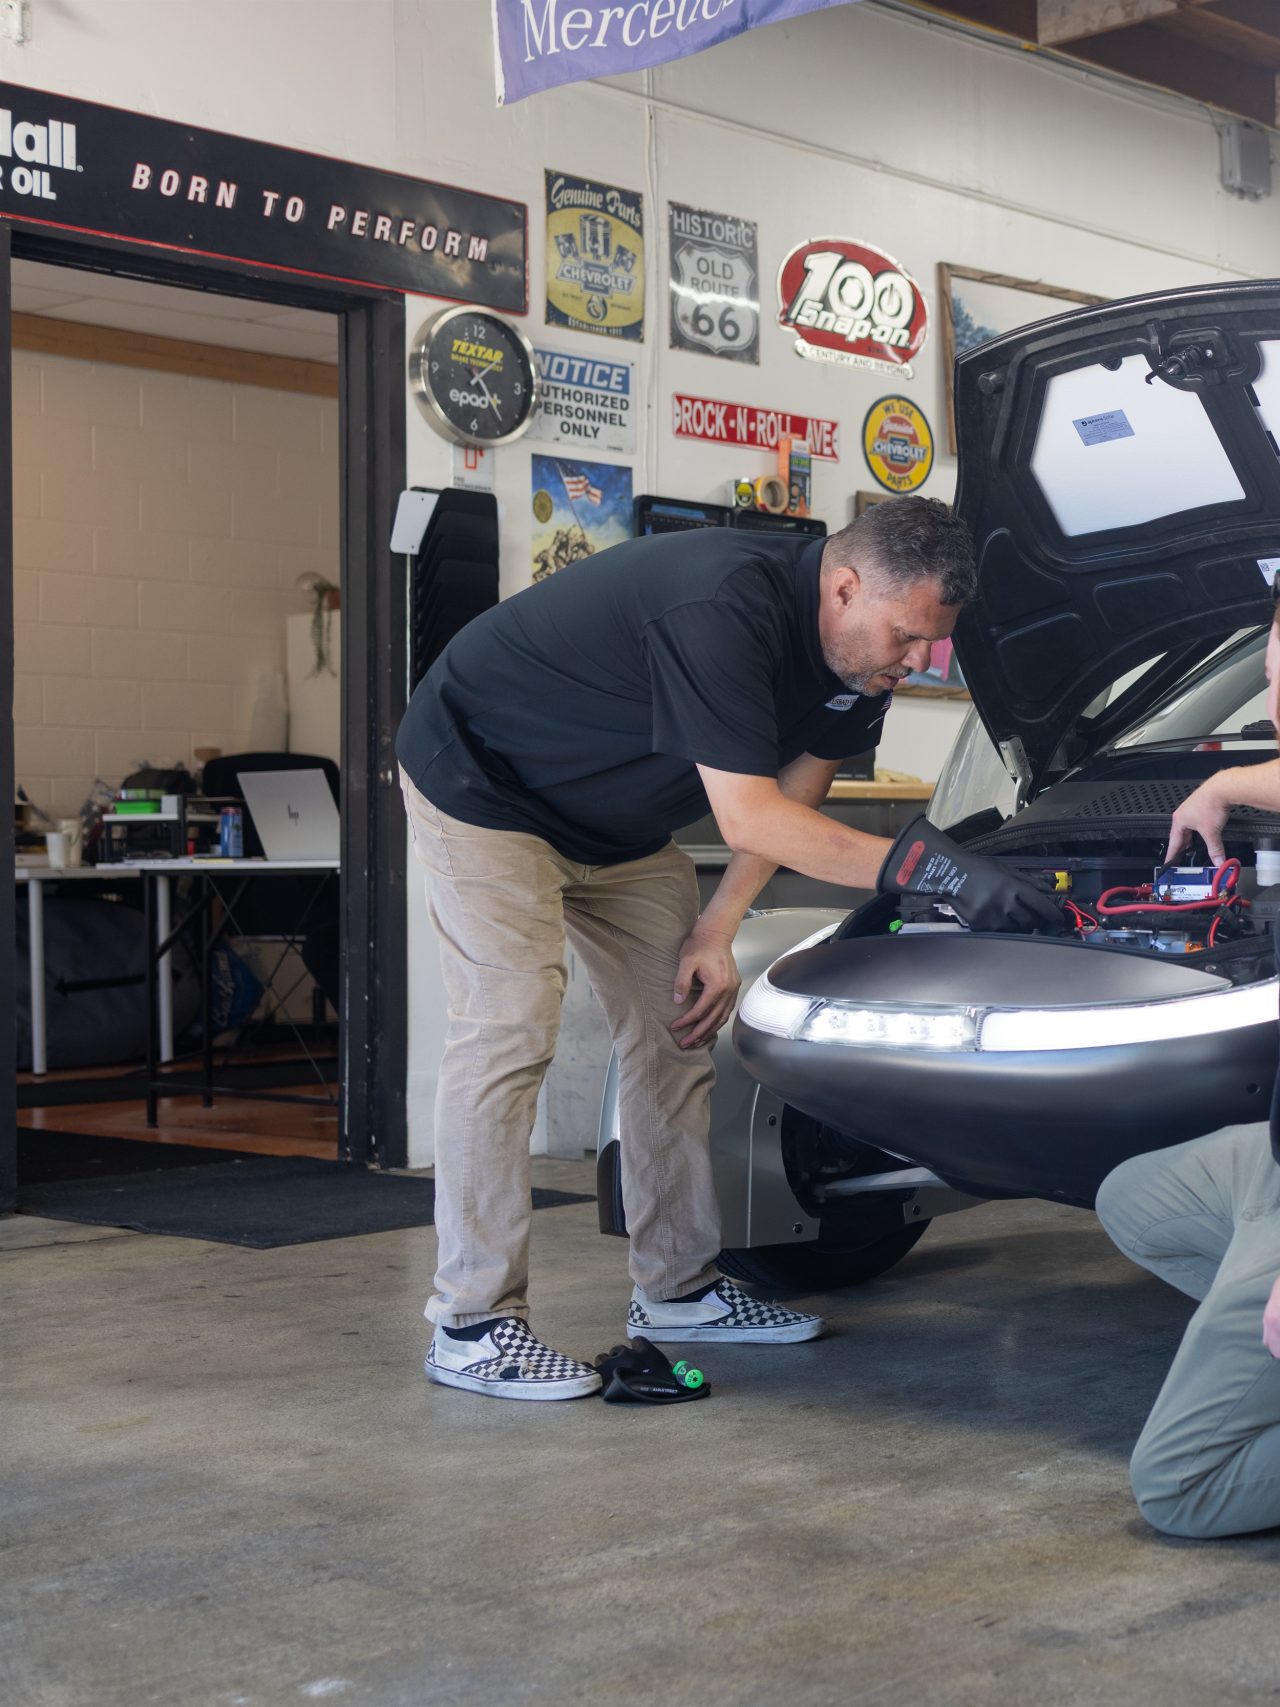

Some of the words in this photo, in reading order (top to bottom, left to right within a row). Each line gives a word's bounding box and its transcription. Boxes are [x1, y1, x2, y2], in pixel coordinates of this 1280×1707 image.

[523, 0, 734, 63] Merced
[11, 166, 57, 200] OIL
[131, 162, 237, 209] BORN
[262, 190, 304, 223] TO
[326, 205, 489, 262] PERFORM
[551, 177, 604, 210] Genuine
[606, 190, 641, 228] Parts
[673, 210, 754, 248] HISTORIC
[562, 265, 630, 291] CHEVROLET
[696, 257, 734, 281] OLD
[690, 276, 740, 299] ROUTE
[789, 251, 915, 331] 100
[473, 324, 486, 340] 12
[692, 303, 740, 342] 66
[796, 300, 911, 348] Snap-on
[452, 339, 504, 363] TEXTAR
[431, 362, 439, 374] 9
[536, 353, 627, 391] NOTICE
[513, 382, 522, 396] 3
[540, 384, 630, 411] UTHORIZED
[470, 418, 478, 431] 6
[560, 421, 600, 439] ONLY
[805, 418, 833, 455] AVE
[874, 441, 926, 460] CHEVROLET
[887, 472, 913, 488] PARTS
